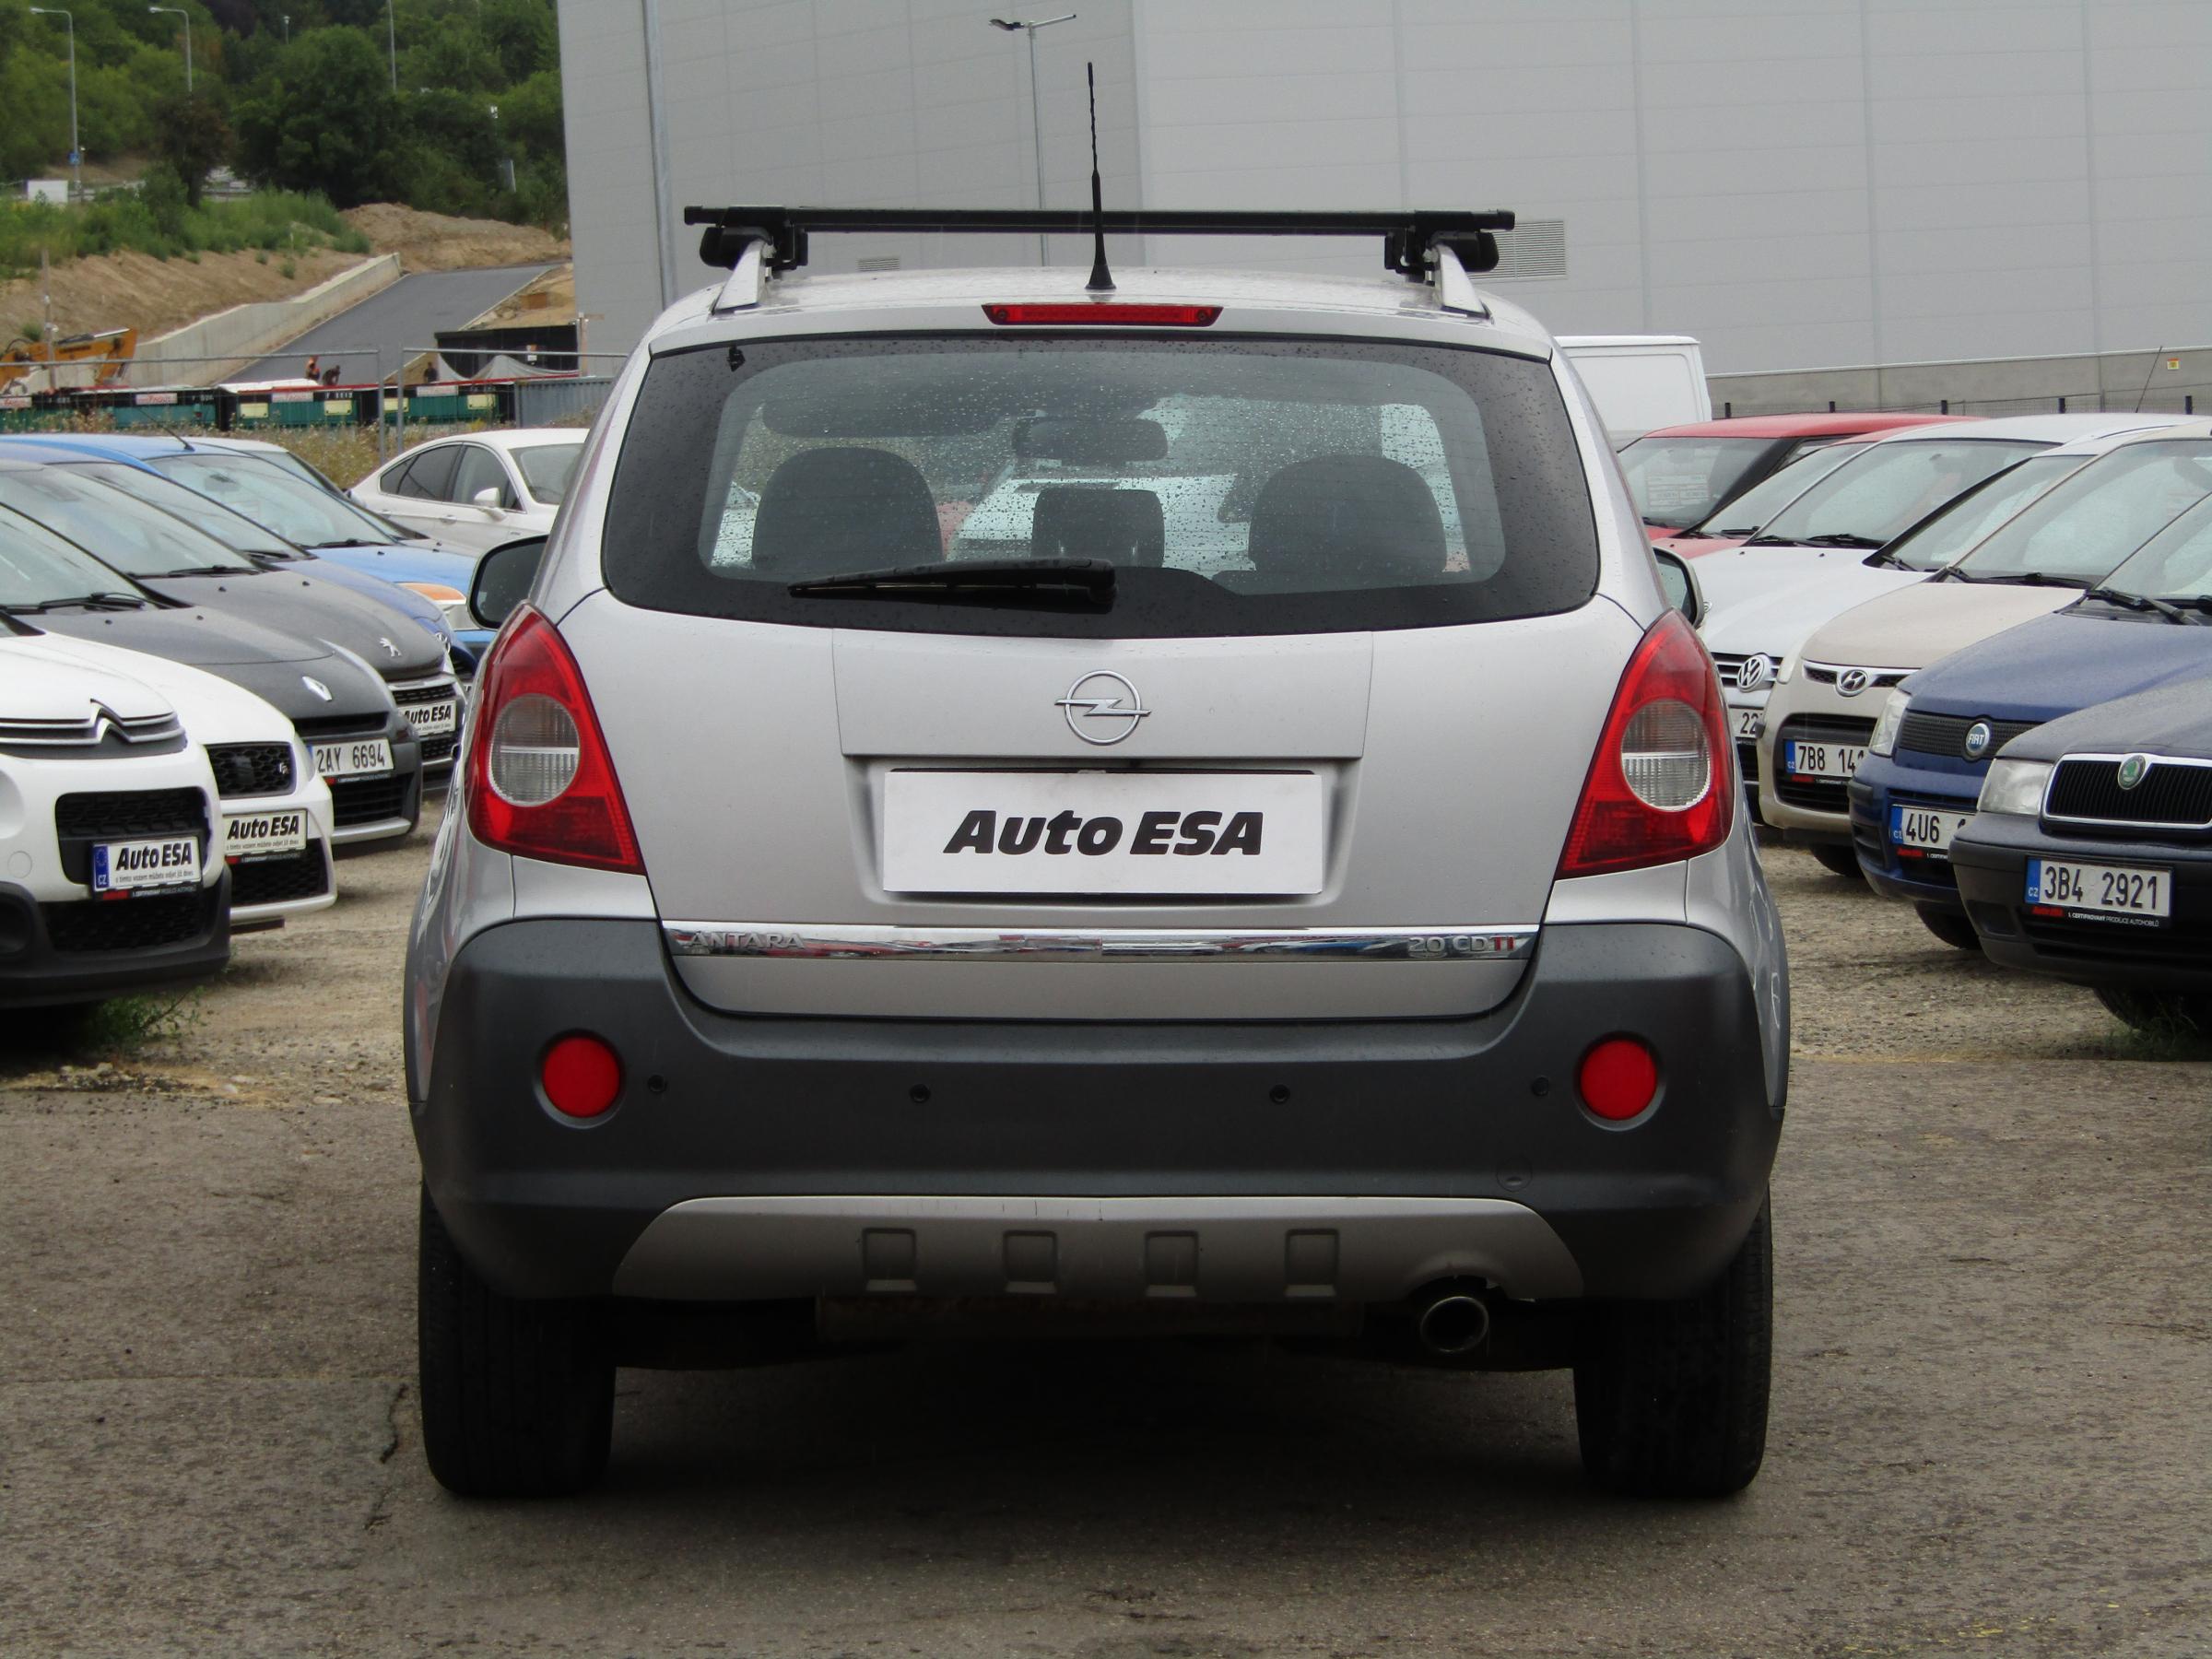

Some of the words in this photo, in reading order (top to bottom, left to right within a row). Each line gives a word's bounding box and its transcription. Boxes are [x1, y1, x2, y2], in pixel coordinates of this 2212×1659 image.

[404, 708, 430, 724] Auto
[431, 704, 452, 722] ESA
[1740, 712, 1763, 735] 22
[1968, 734, 1984, 745] FIAT
[317, 747, 341, 773] 2AY
[353, 743, 385, 769] 6694
[1798, 746, 1826, 771] 7B8
[227, 818, 269, 841] Auto
[270, 815, 300, 837] ESA
[943, 810, 1124, 855] Auto
[1129, 811, 1264, 855] ESA
[1906, 813, 1940, 844] 4U6
[115, 845, 160, 871] Auto
[161, 842, 193, 866] ESA
[98, 875, 108, 886] CZ
[2044, 865, 2084, 902] 3B4
[2100, 871, 2159, 910] 2921
[2028, 888, 2040, 898] CZ
[690, 931, 805, 948] ANTARA
[1451, 935, 1516, 952] CDTI
